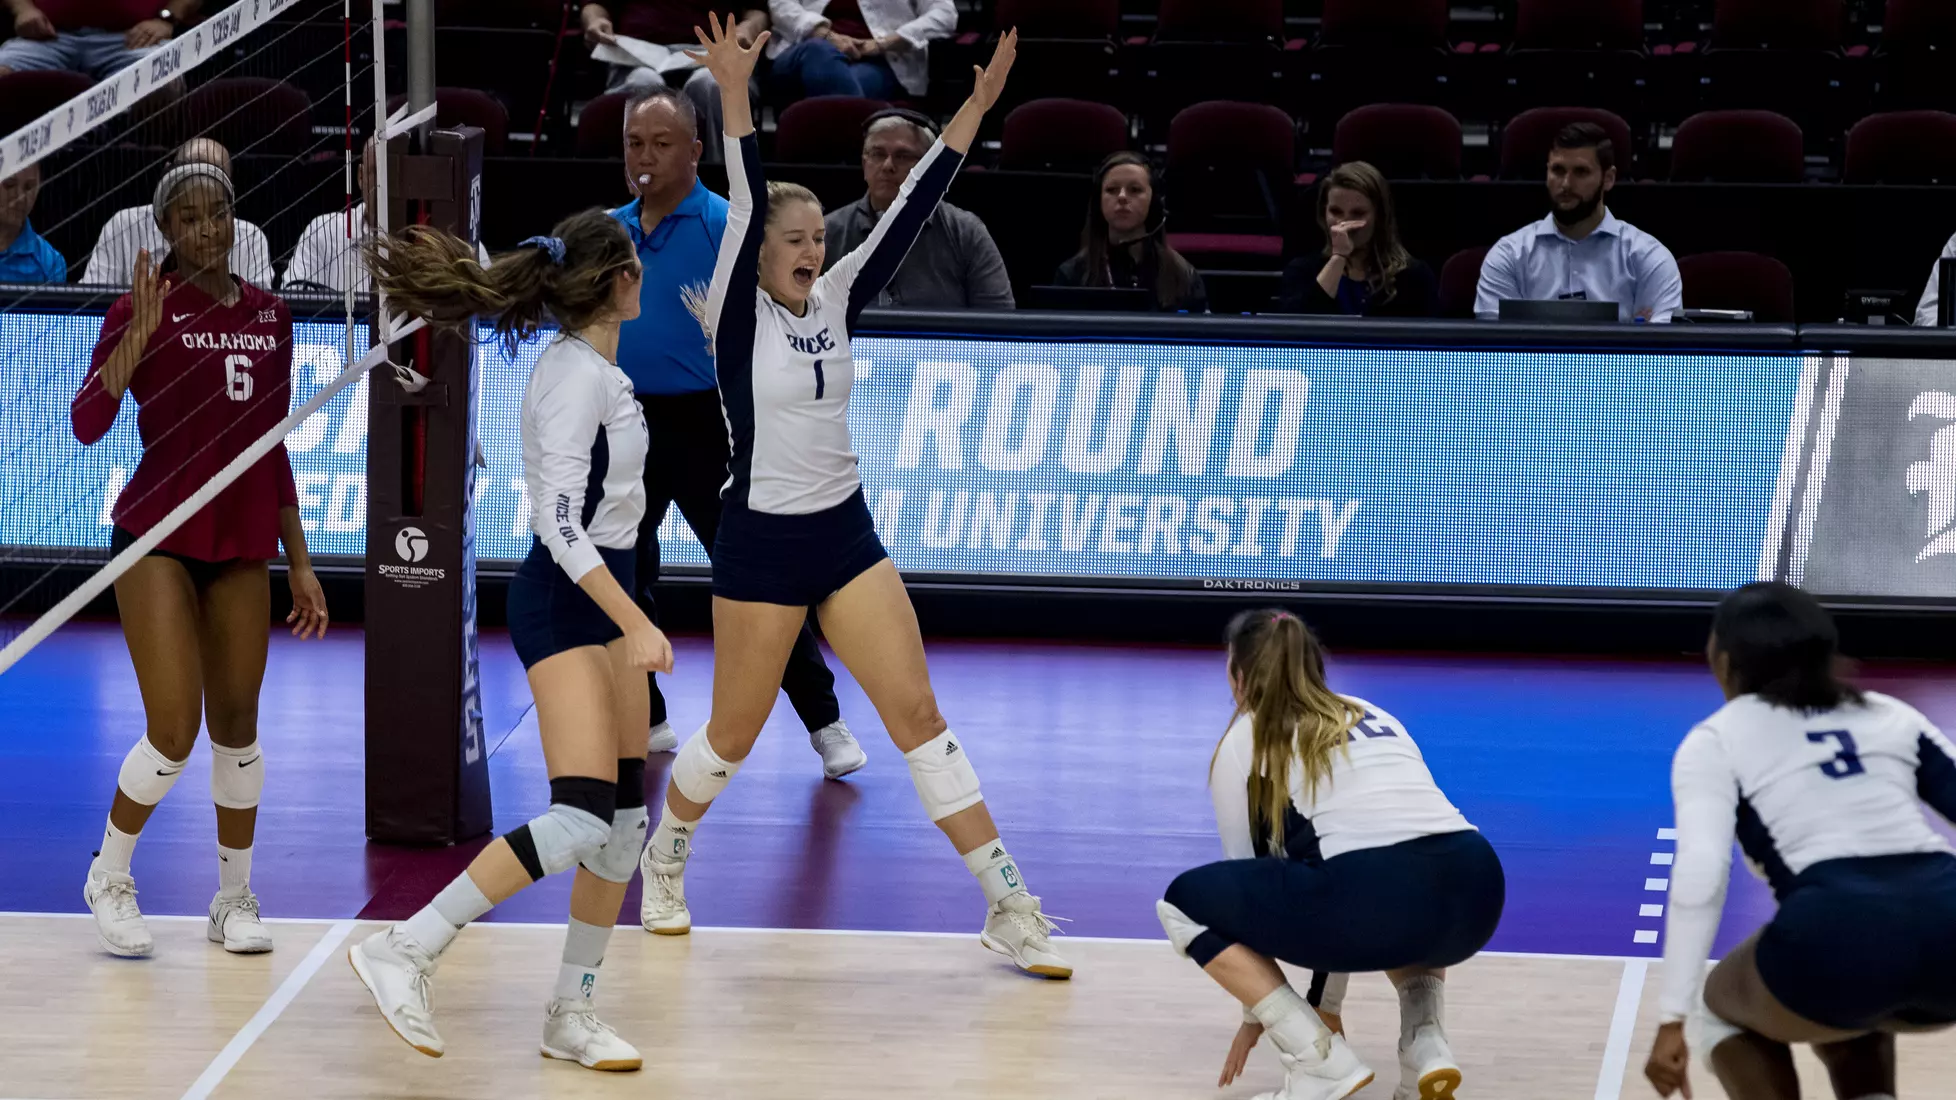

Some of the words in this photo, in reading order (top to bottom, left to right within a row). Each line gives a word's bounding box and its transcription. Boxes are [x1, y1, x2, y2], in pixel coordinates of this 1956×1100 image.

[181, 332, 277, 351] OKLAHOMA
[786, 327, 836, 354] RICE
[225, 354, 254, 401] 6
[813, 359, 825, 401] 1
[894, 361, 1310, 480] ROUND
[555, 493, 570, 523] RICE
[920, 488, 1360, 559] UNIVERSITY
[378, 564, 409, 575] SPORTS
[410, 567, 445, 579] IMPORTS
[1203, 580, 1300, 590] DAKTRONICS
[1806, 730, 1867, 780] 3
